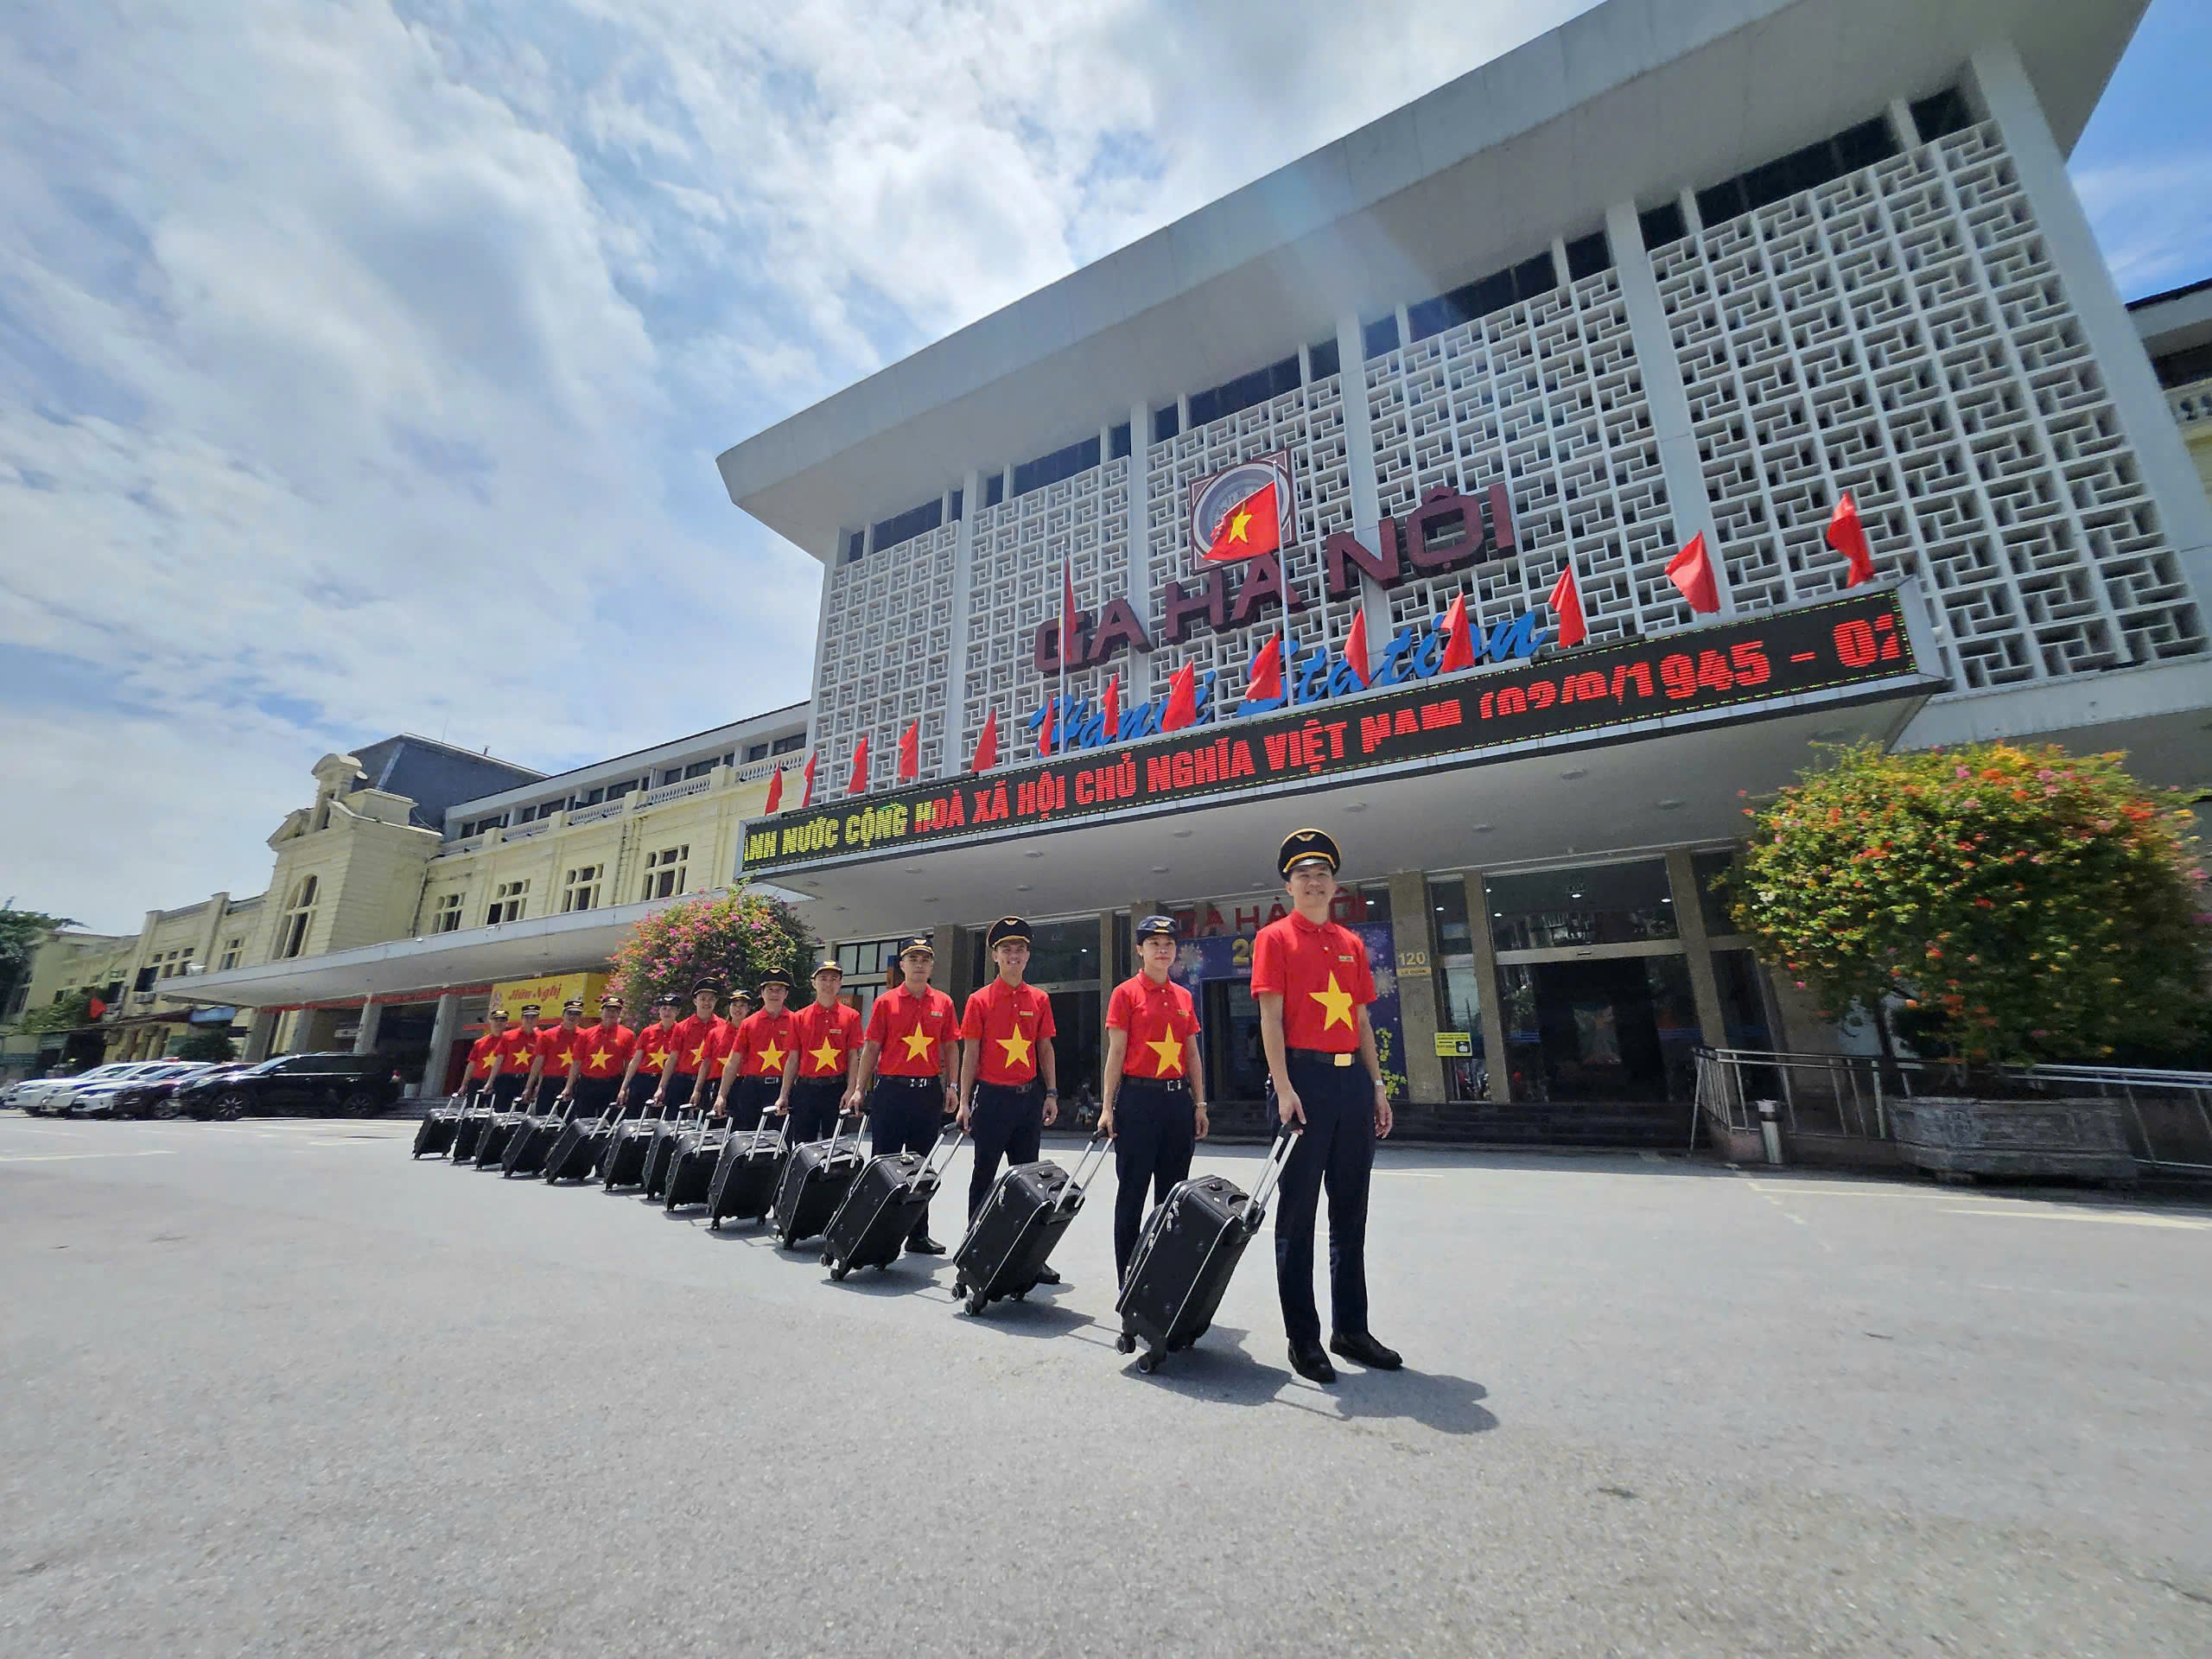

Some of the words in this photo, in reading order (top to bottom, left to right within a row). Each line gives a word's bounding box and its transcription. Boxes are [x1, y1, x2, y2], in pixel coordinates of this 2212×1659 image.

[1034, 596, 1155, 677] GA
[1326, 484, 1518, 603] NỘI
[781, 816, 840, 855] NƯỚC
[845, 802, 907, 848] CỘNG
[914, 789, 965, 834] HOÀ
[971, 780, 1009, 823] XÃ
[1017, 772, 1065, 819] HỘI
[1075, 752, 1137, 805] CHỦ
[1147, 736, 1255, 793] NGHĨA
[1263, 719, 1348, 773] VIỆT
[1360, 699, 1462, 753] NAM
[1399, 951, 1426, 965] 120
